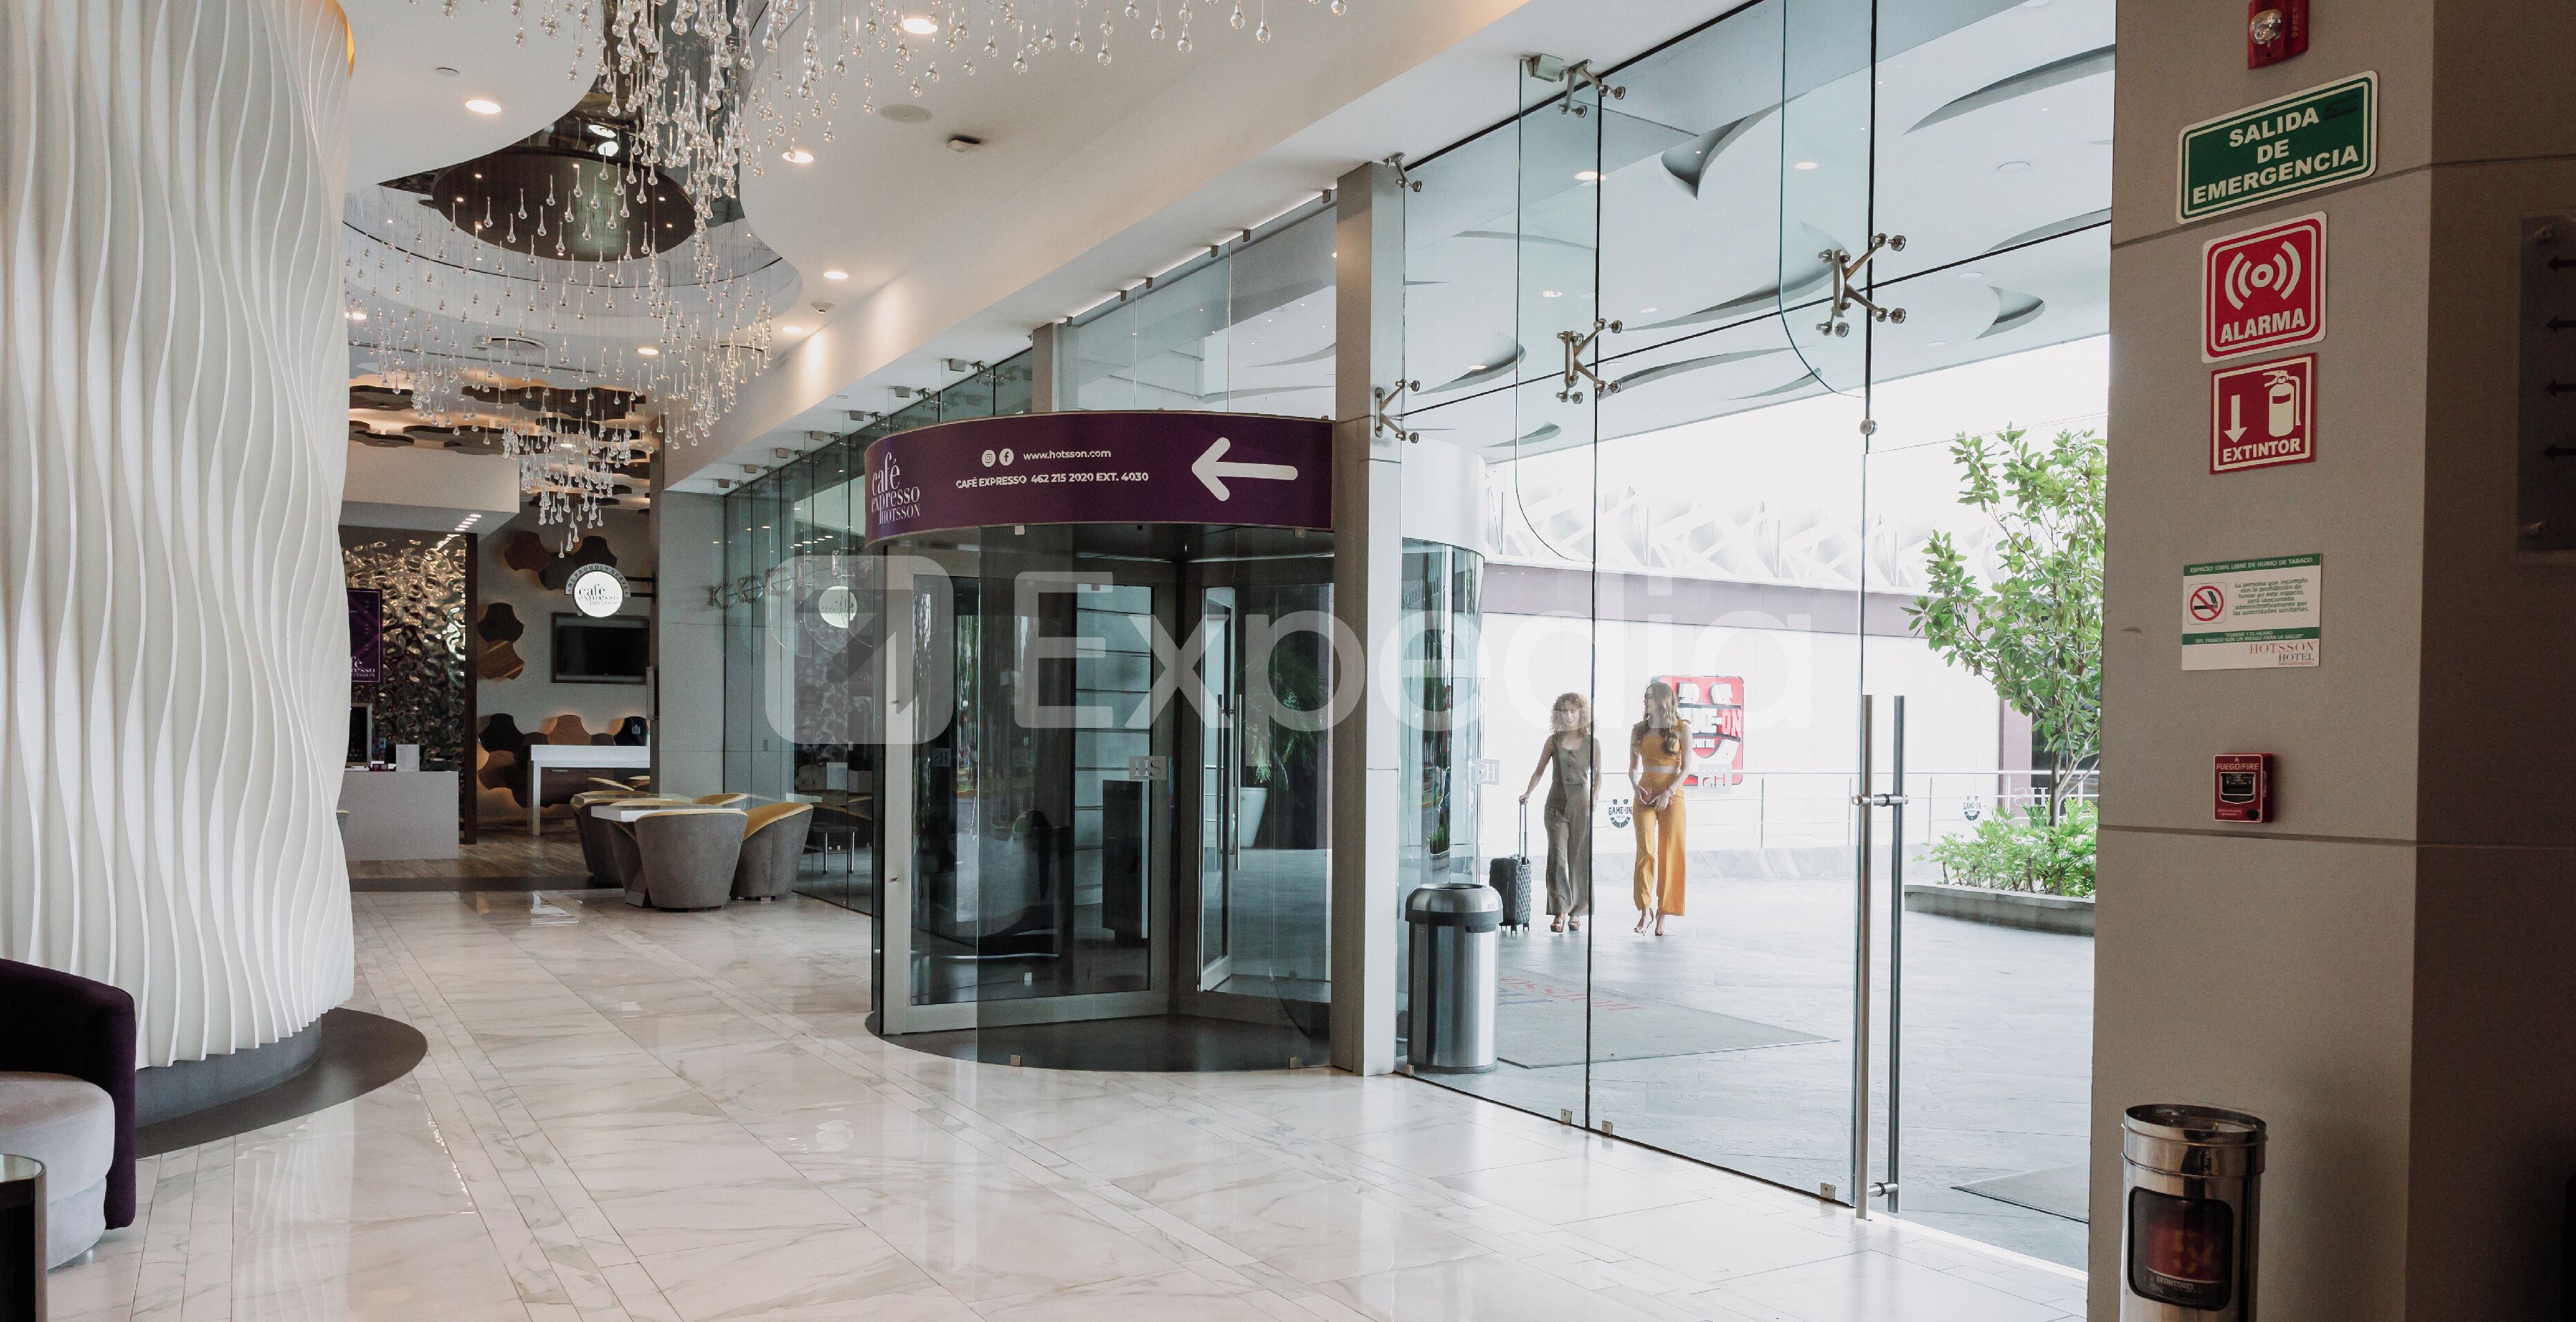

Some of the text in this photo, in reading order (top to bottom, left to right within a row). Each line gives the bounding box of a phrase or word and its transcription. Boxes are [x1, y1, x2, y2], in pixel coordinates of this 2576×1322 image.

[2229, 106, 2320, 147] SALIDA
[2257, 139, 2290, 164] DE
[2193, 145, 2359, 205] EMERGENCIA
[2220, 308, 2306, 344] ALARMA
[1023, 450, 1111, 460] www.hotsson.com
[2223, 438, 2301, 463] EXTINTOR
[872, 451, 900, 496] café
[955, 472, 1149, 489] CAFÉ EXPRESSO 462 215 2020 EXT. 4030
[871, 486, 920, 525] expresso
[881, 503, 920, 523] HOTSSON
[575, 565, 609, 577] PROUDLY
[2250, 642, 2315, 654] HOTSSON
[2279, 653, 2314, 662] HOTEL
[1609, 806, 1632, 815] GAME-ON
